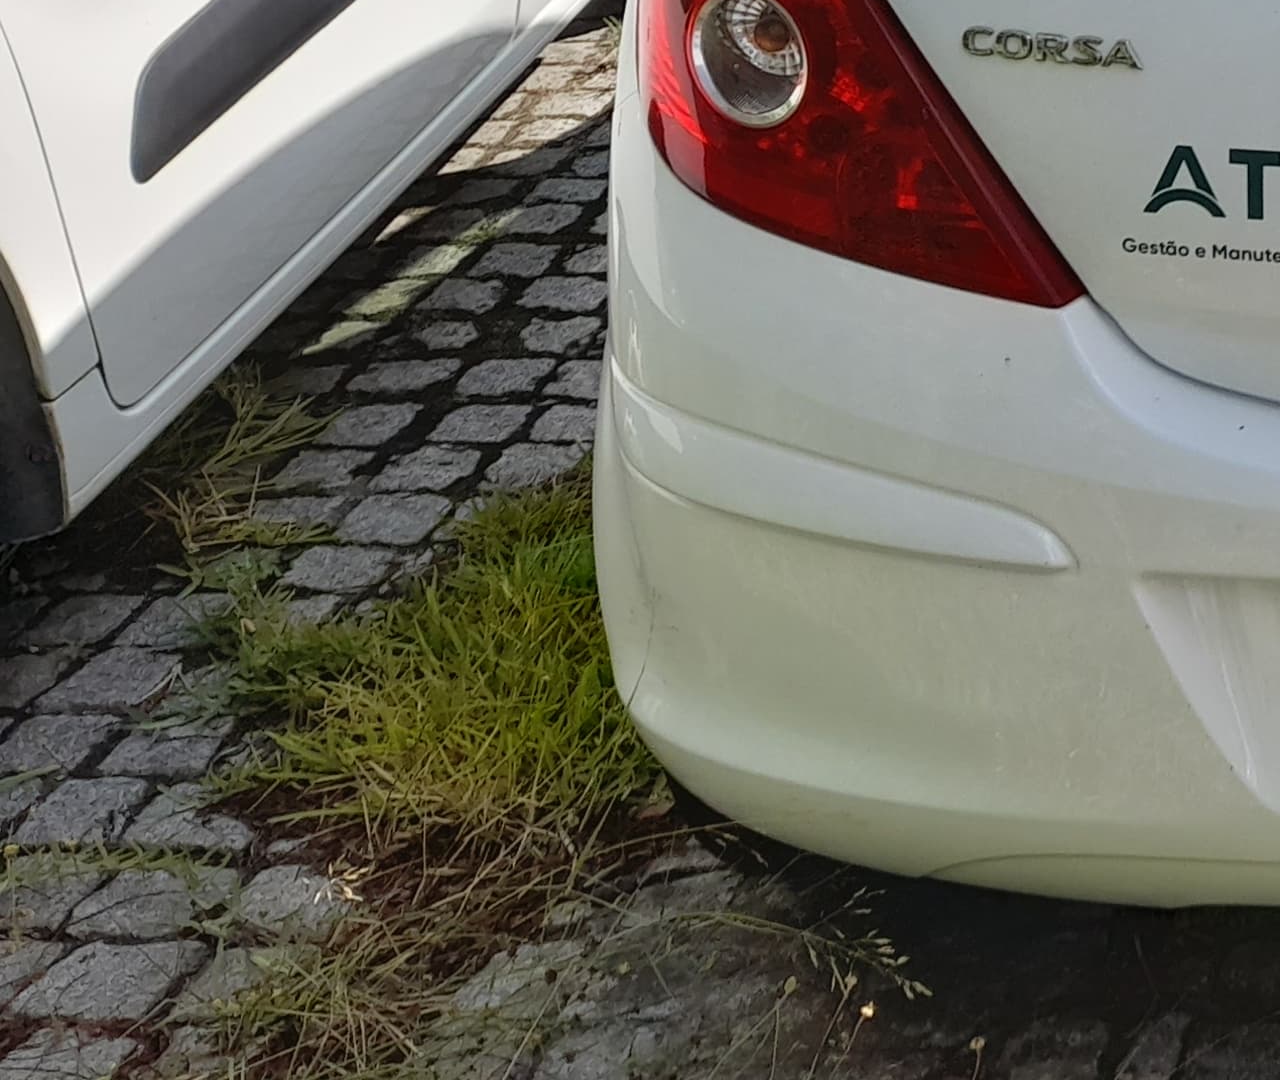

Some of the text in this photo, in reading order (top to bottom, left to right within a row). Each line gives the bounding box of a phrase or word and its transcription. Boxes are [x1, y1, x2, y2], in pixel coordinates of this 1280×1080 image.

[962, 26, 1144, 70] CORSA
[1122, 237, 1189, 257] Gestão
[1195, 247, 1206, 258] e
